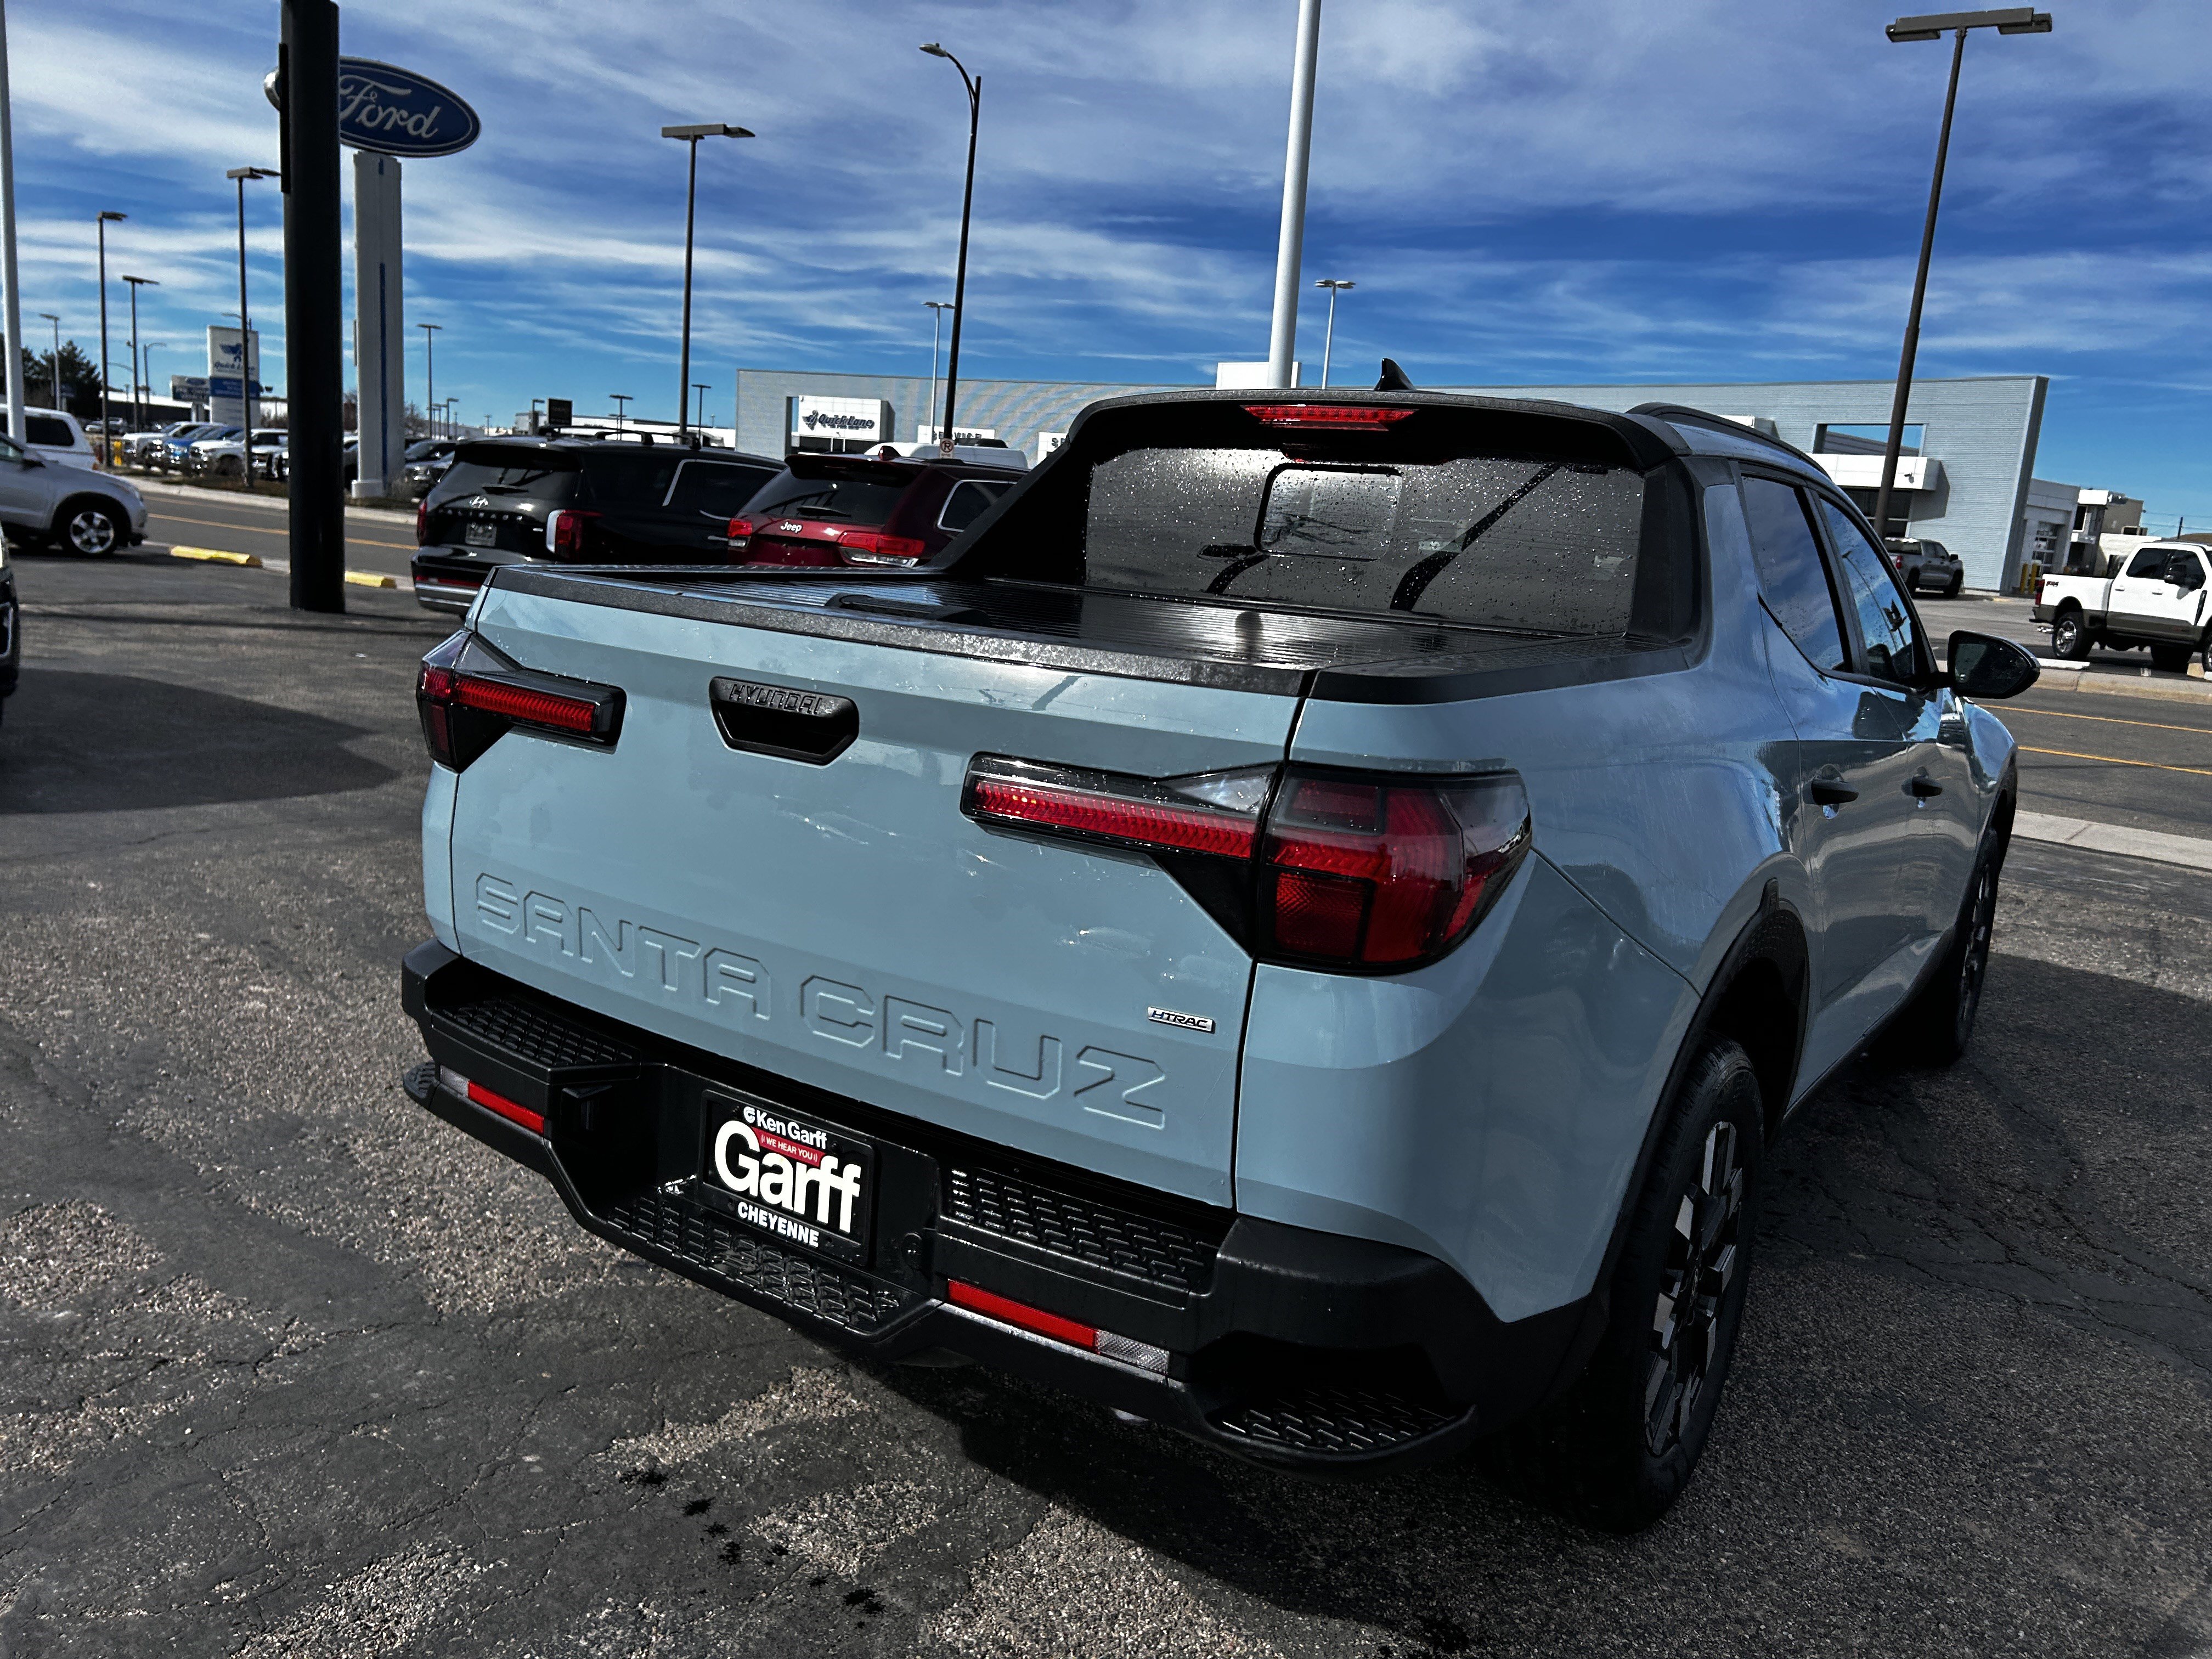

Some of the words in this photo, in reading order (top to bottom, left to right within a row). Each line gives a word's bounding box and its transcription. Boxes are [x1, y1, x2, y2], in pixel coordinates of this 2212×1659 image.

[340, 75, 441, 138] Ford
[819, 414, 847, 426] Quick
[847, 416, 873, 427] Lane
[780, 521, 802, 533] Jeep
[729, 684, 822, 715] HYUNDAI
[476, 872, 771, 1020] SANTA
[800, 975, 1166, 1131] CRUZ
[1152, 1010, 1208, 1029] HTRAC
[757, 1109, 786, 1136] Ken
[787, 1121, 827, 1149] Garff
[766, 1137, 777, 1147] WE
[778, 1141, 797, 1154] HEAR
[798, 1149, 813, 1160] YOU
[714, 1120, 861, 1234] Garff
[737, 1201, 820, 1248] CHEYENNE
